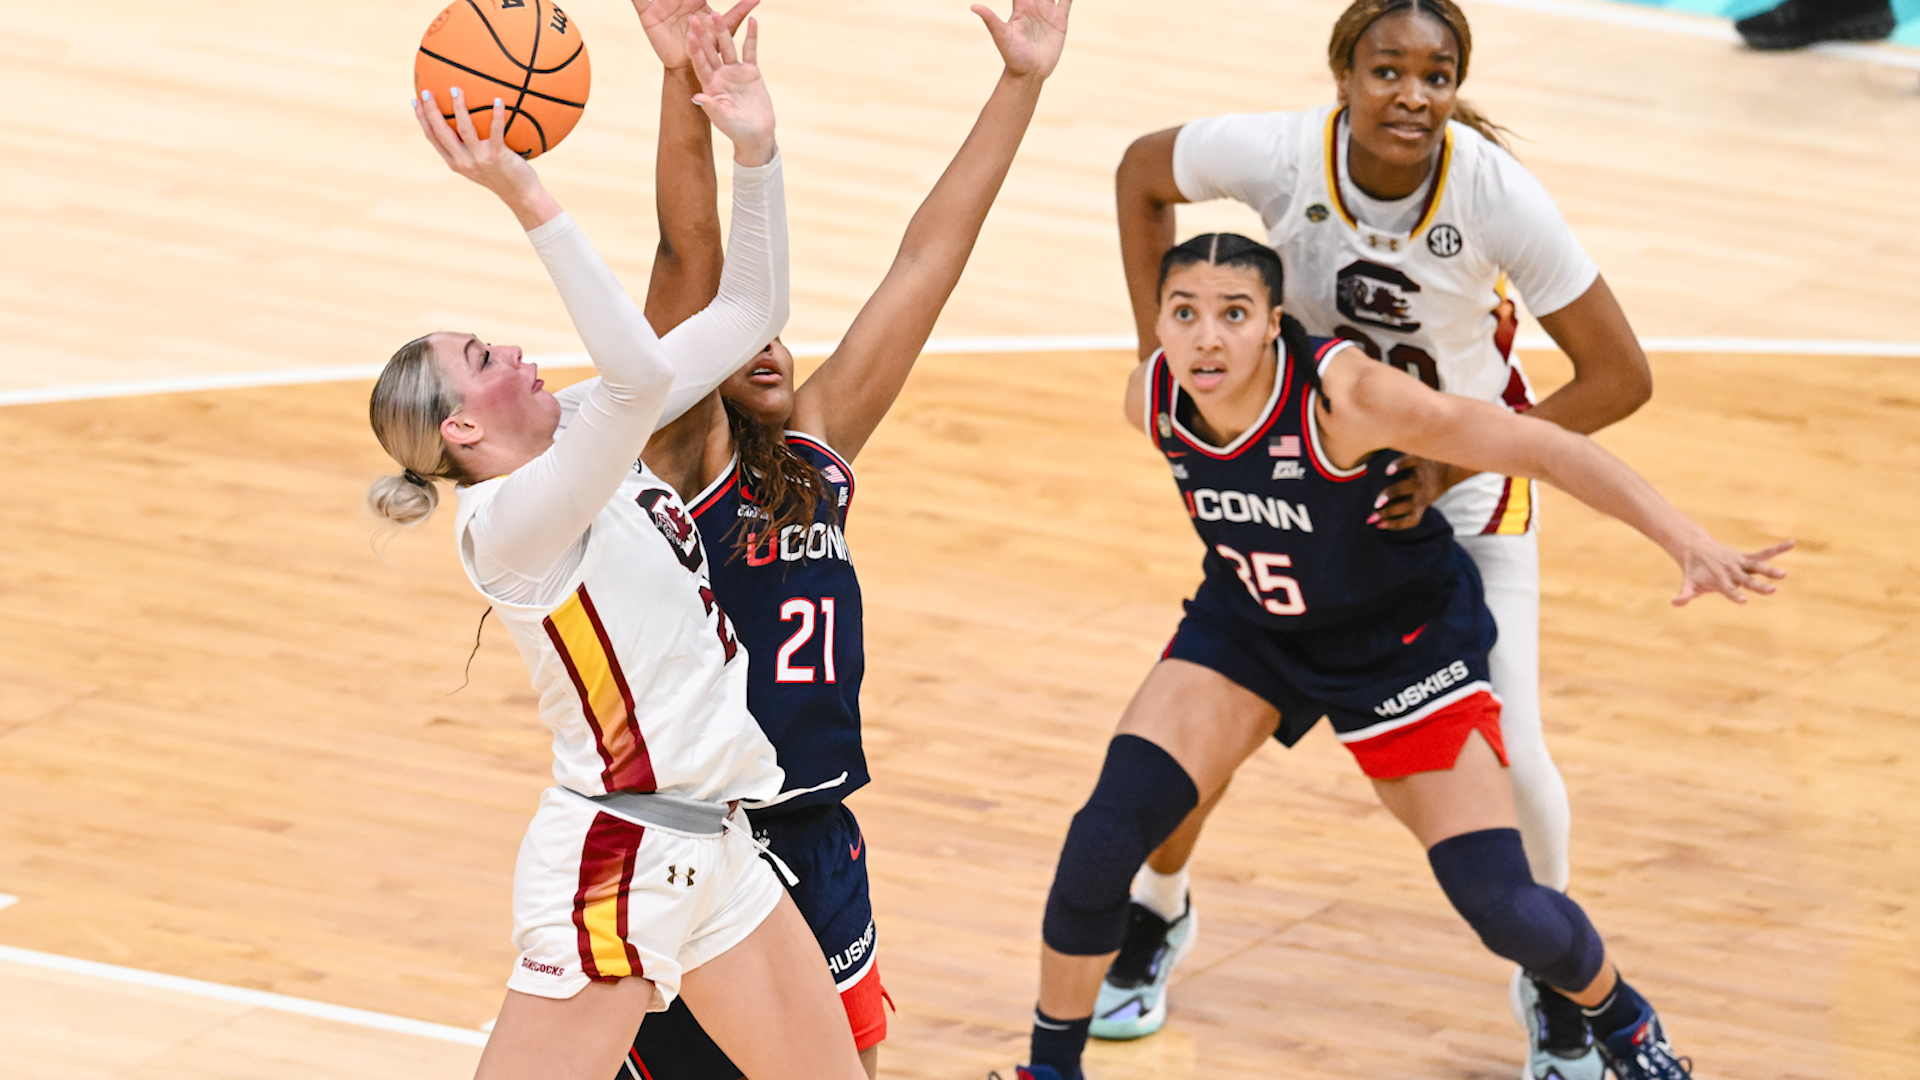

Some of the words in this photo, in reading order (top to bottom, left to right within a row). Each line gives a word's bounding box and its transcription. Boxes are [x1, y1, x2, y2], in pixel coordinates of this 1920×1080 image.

[1429, 226, 1460, 256] SEC
[774, 596, 837, 685] 21
[1373, 659, 1470, 719] HUSKIES
